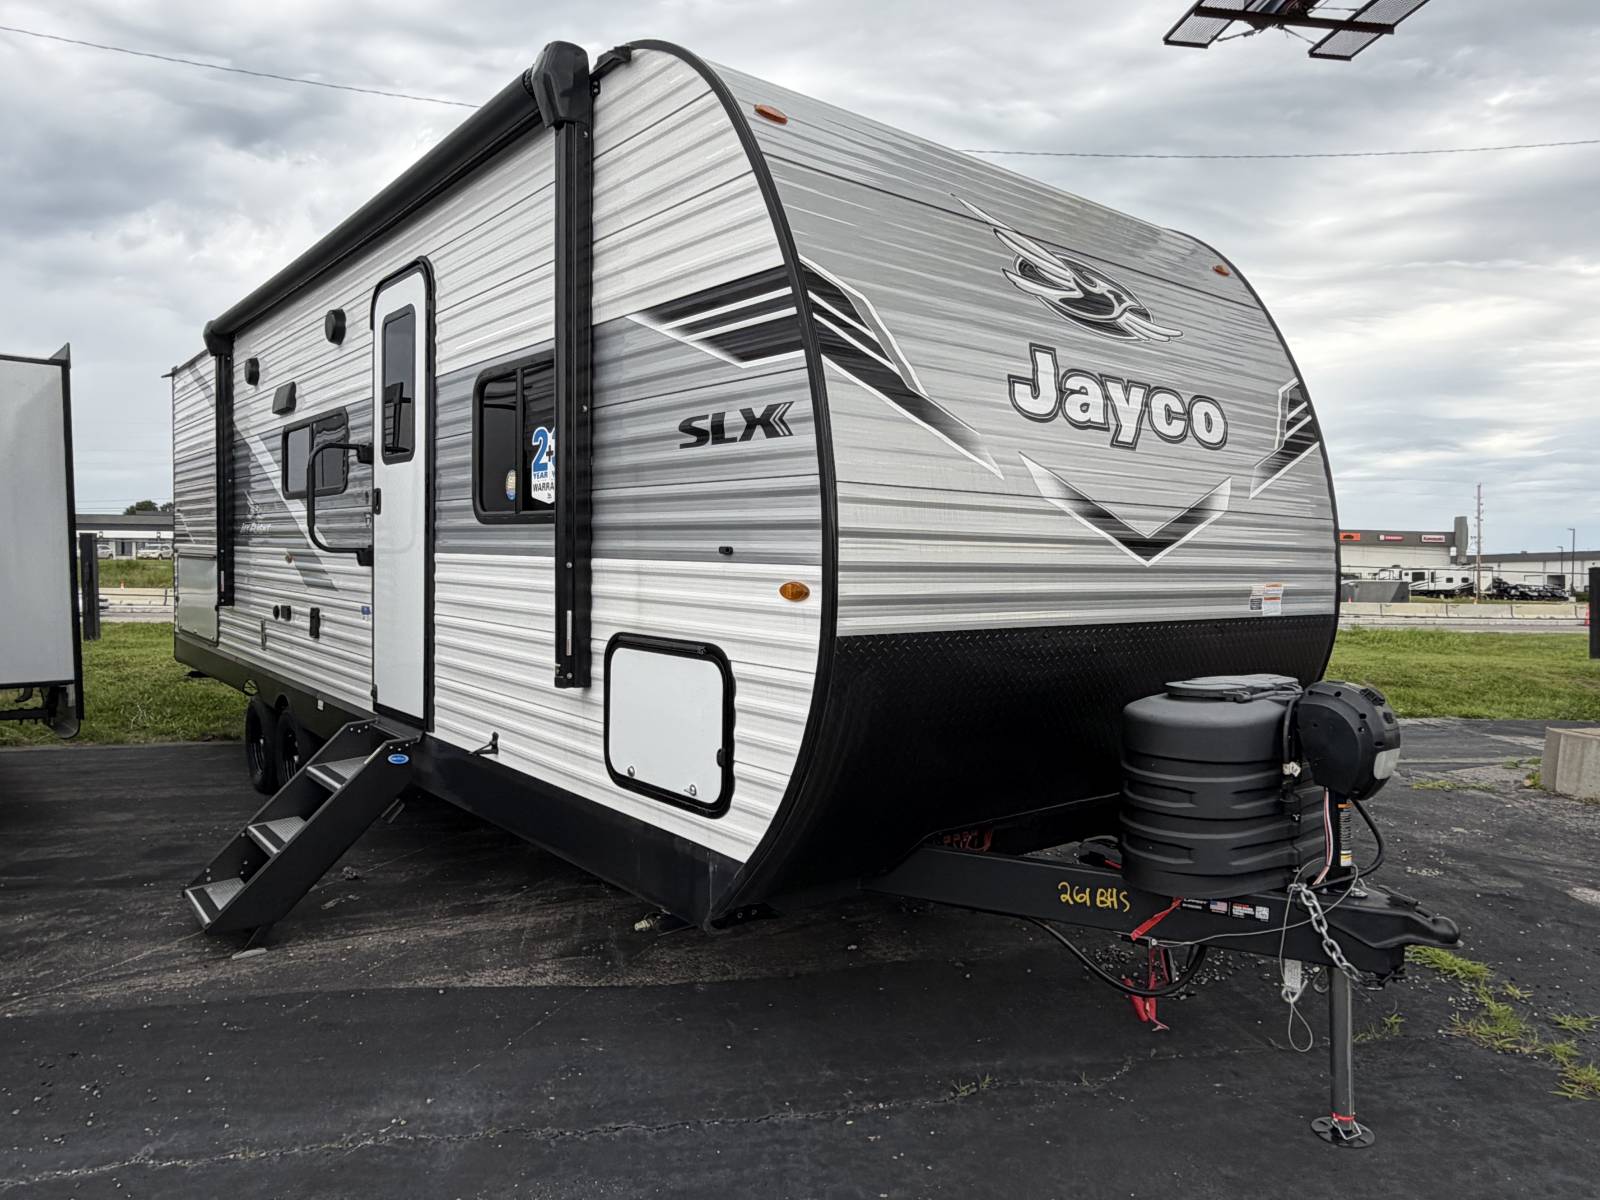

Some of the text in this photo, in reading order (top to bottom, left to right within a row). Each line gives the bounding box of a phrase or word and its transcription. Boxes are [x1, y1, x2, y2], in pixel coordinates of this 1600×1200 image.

[1007, 342, 1228, 450] Jayco
[678, 401, 794, 449] SLX
[533, 471, 549, 480] YEAR
[1058, 881, 1131, 912] 261 BHS
